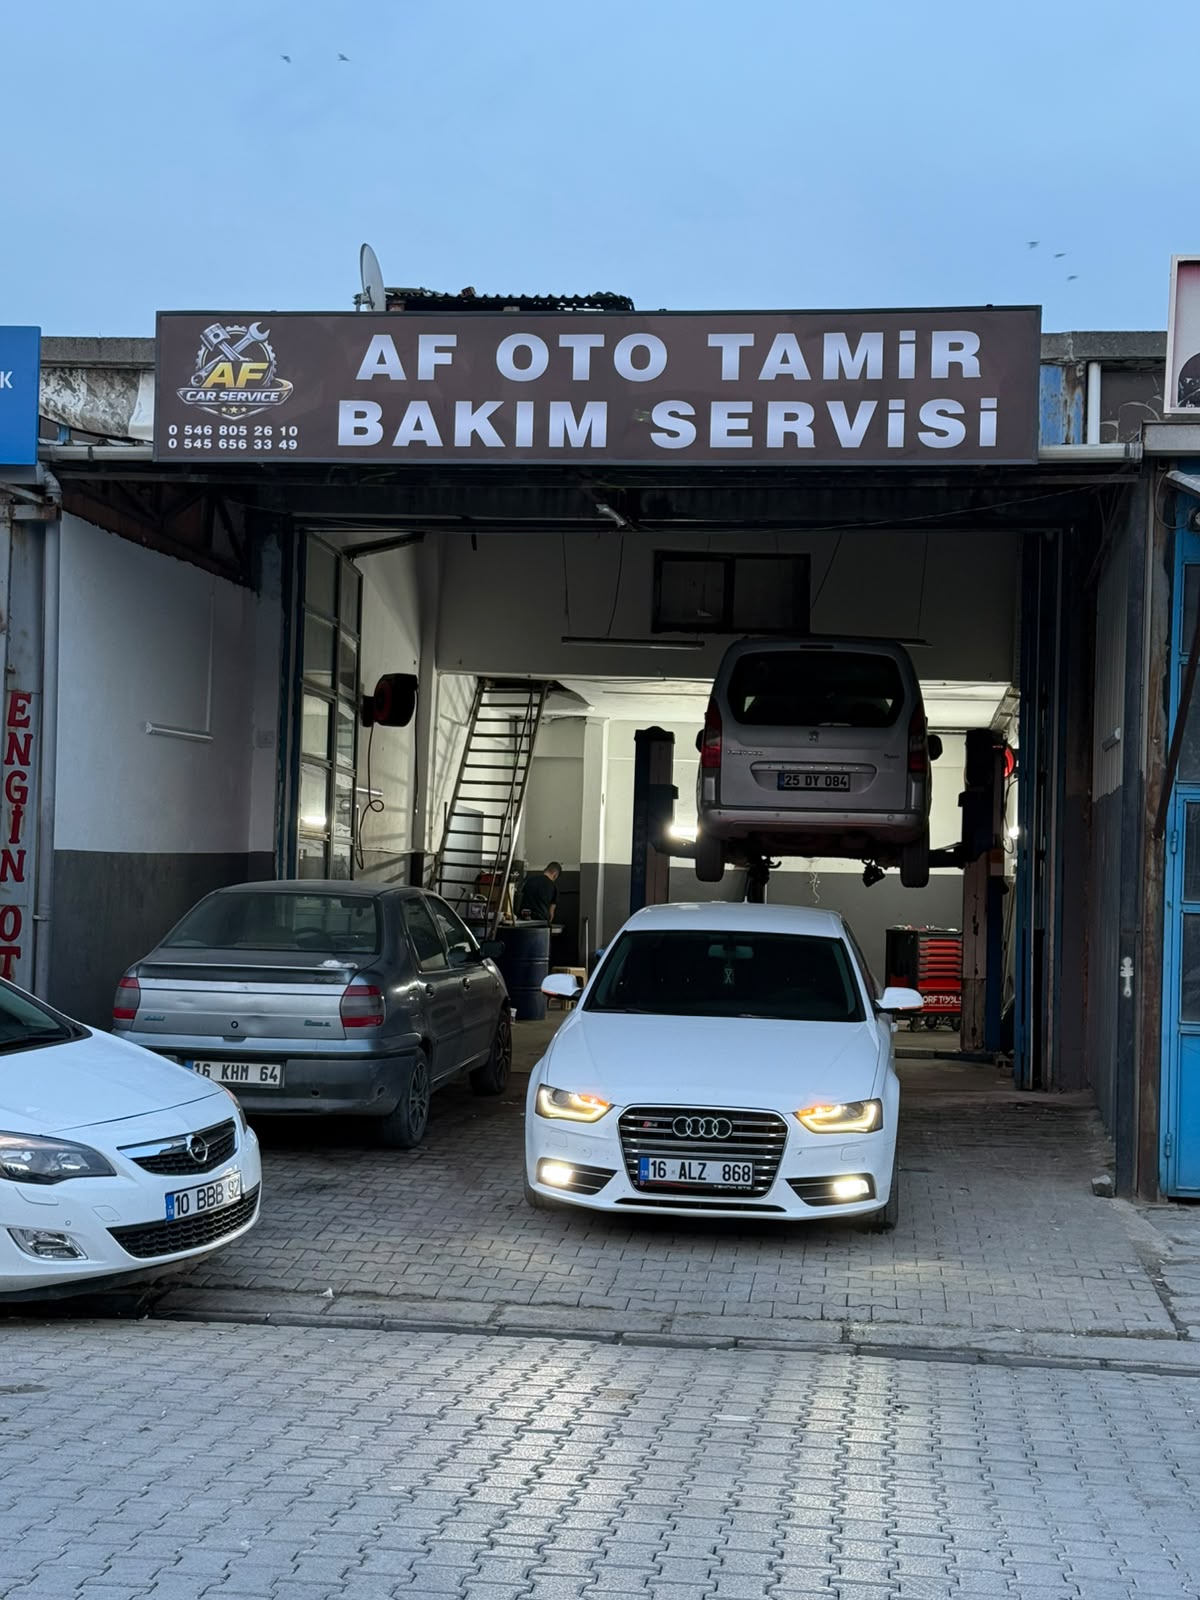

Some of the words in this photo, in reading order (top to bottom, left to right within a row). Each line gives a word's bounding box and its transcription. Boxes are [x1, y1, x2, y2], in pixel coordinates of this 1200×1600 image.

[355, 333, 458, 382] AF
[495, 332, 668, 383] OTO
[201, 361, 270, 389] AF
[185, 390, 217, 402] CAR
[218, 390, 281, 402] SERVICE
[168, 424, 178, 436] 0
[183, 424, 213, 436] 546
[218, 424, 248, 436] 805
[253, 425, 273, 437] 26
[279, 425, 298, 437] 10
[337, 400, 608, 449] BAKIM
[167, 438, 178, 449] 0
[183, 438, 212, 449] 545
[218, 438, 248, 450] 656
[253, 439, 273, 450] 33
[278, 439, 298, 450] 49
[784, 774, 800, 787] 25
[804, 775, 820, 787] DY
[824, 775, 848, 788] 084
[221, 1063, 250, 1081] KHM
[259, 1065, 279, 1082] 64
[650, 1159, 667, 1179] 16
[678, 1161, 708, 1182] ALZ
[722, 1164, 752, 1183] 868
[174, 1192, 190, 1216] 10
[196, 1181, 225, 1211] BBB
